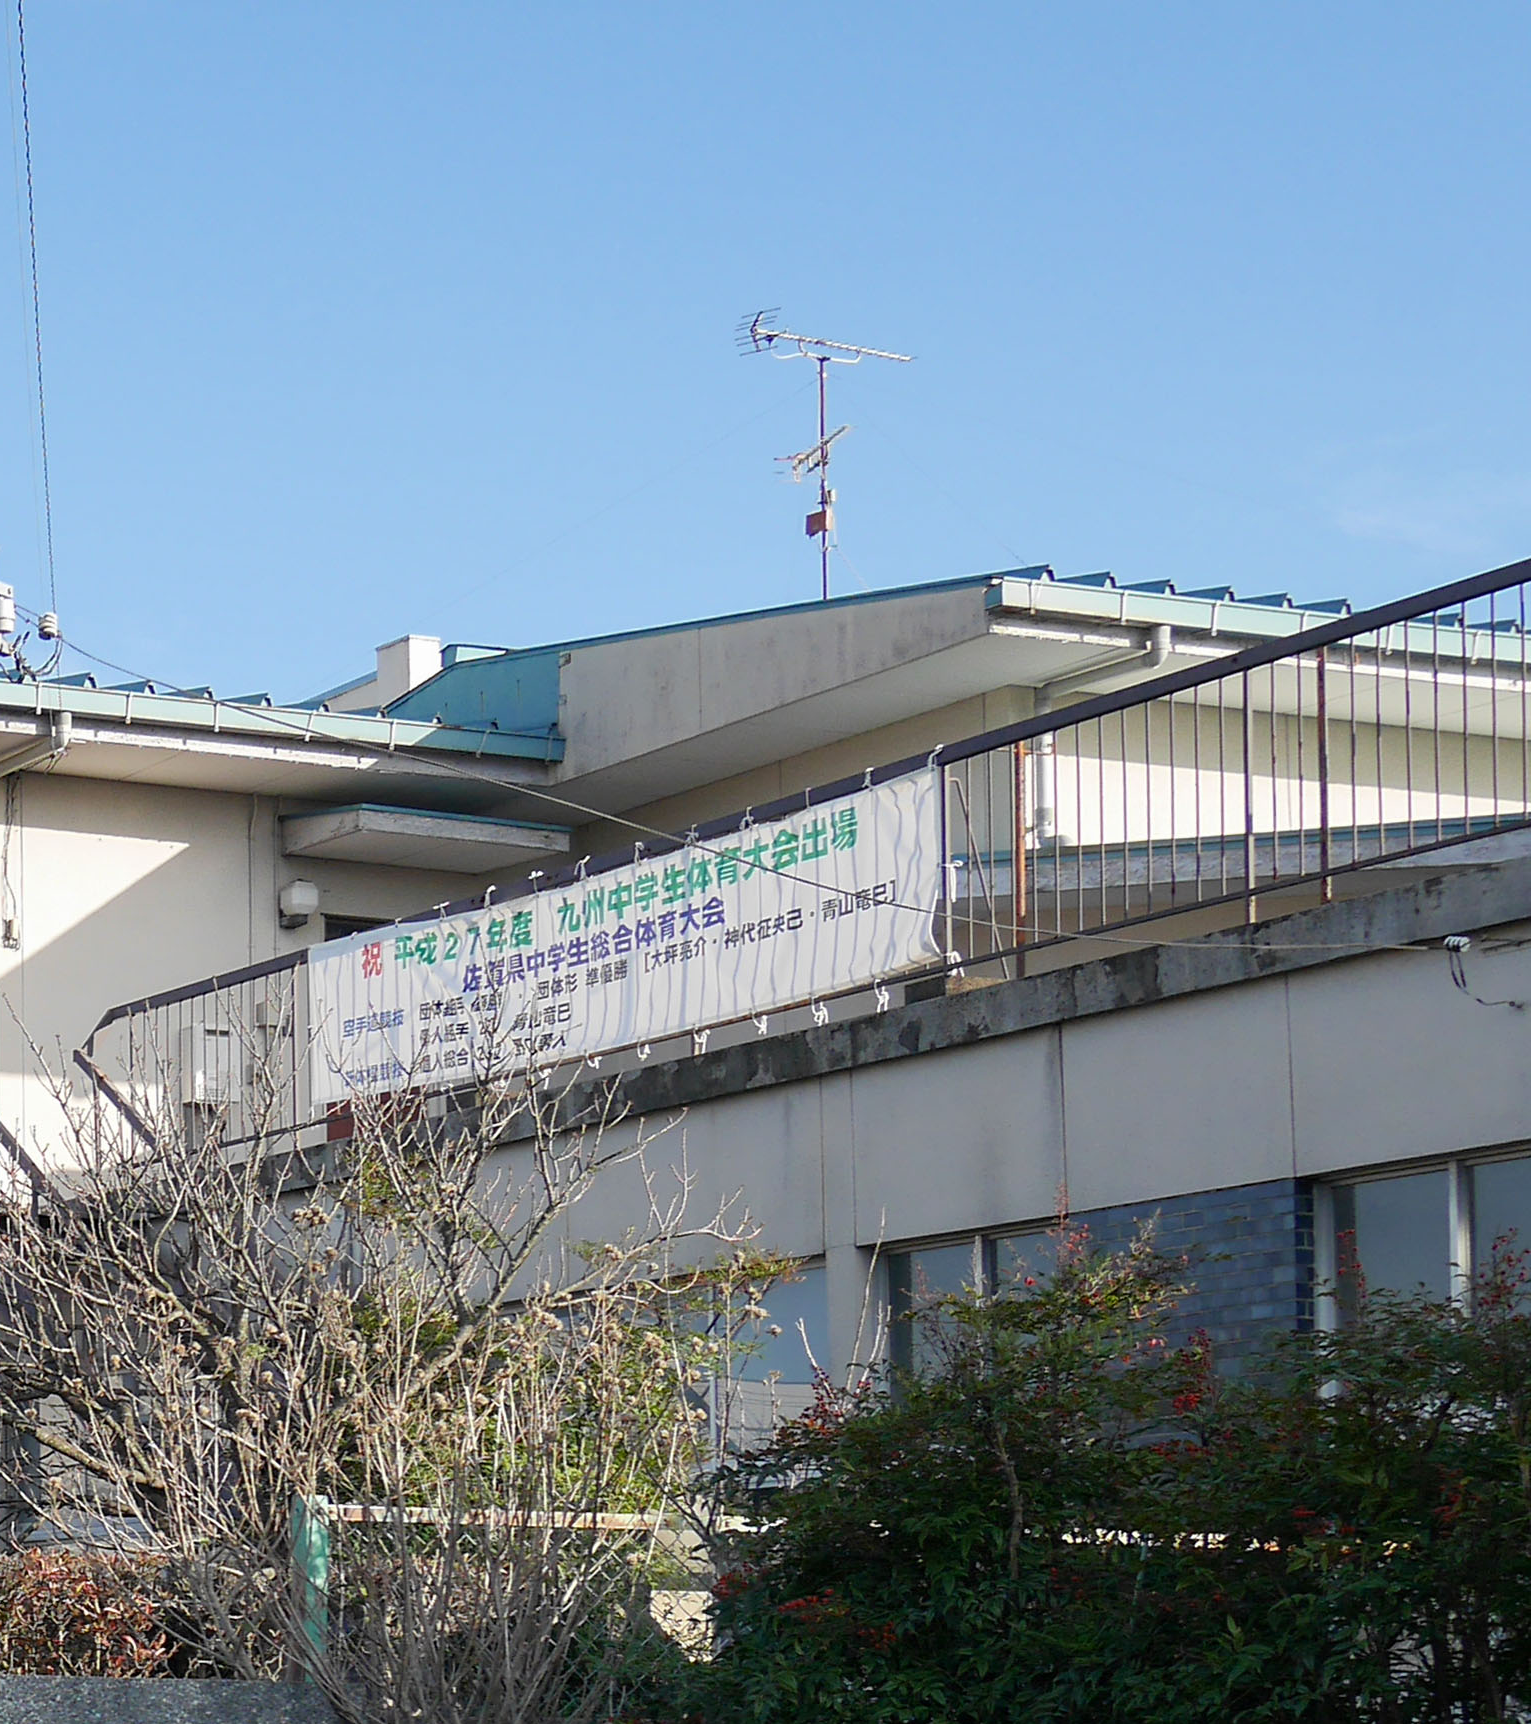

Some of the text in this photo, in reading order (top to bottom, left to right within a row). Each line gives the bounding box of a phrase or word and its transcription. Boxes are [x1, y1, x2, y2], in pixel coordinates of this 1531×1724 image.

[361, 941, 383, 978] 祝
[558, 806, 858, 934] 九州中学生体育大会出場
[462, 897, 725, 994] 佐賀県中学生総合体育大会
